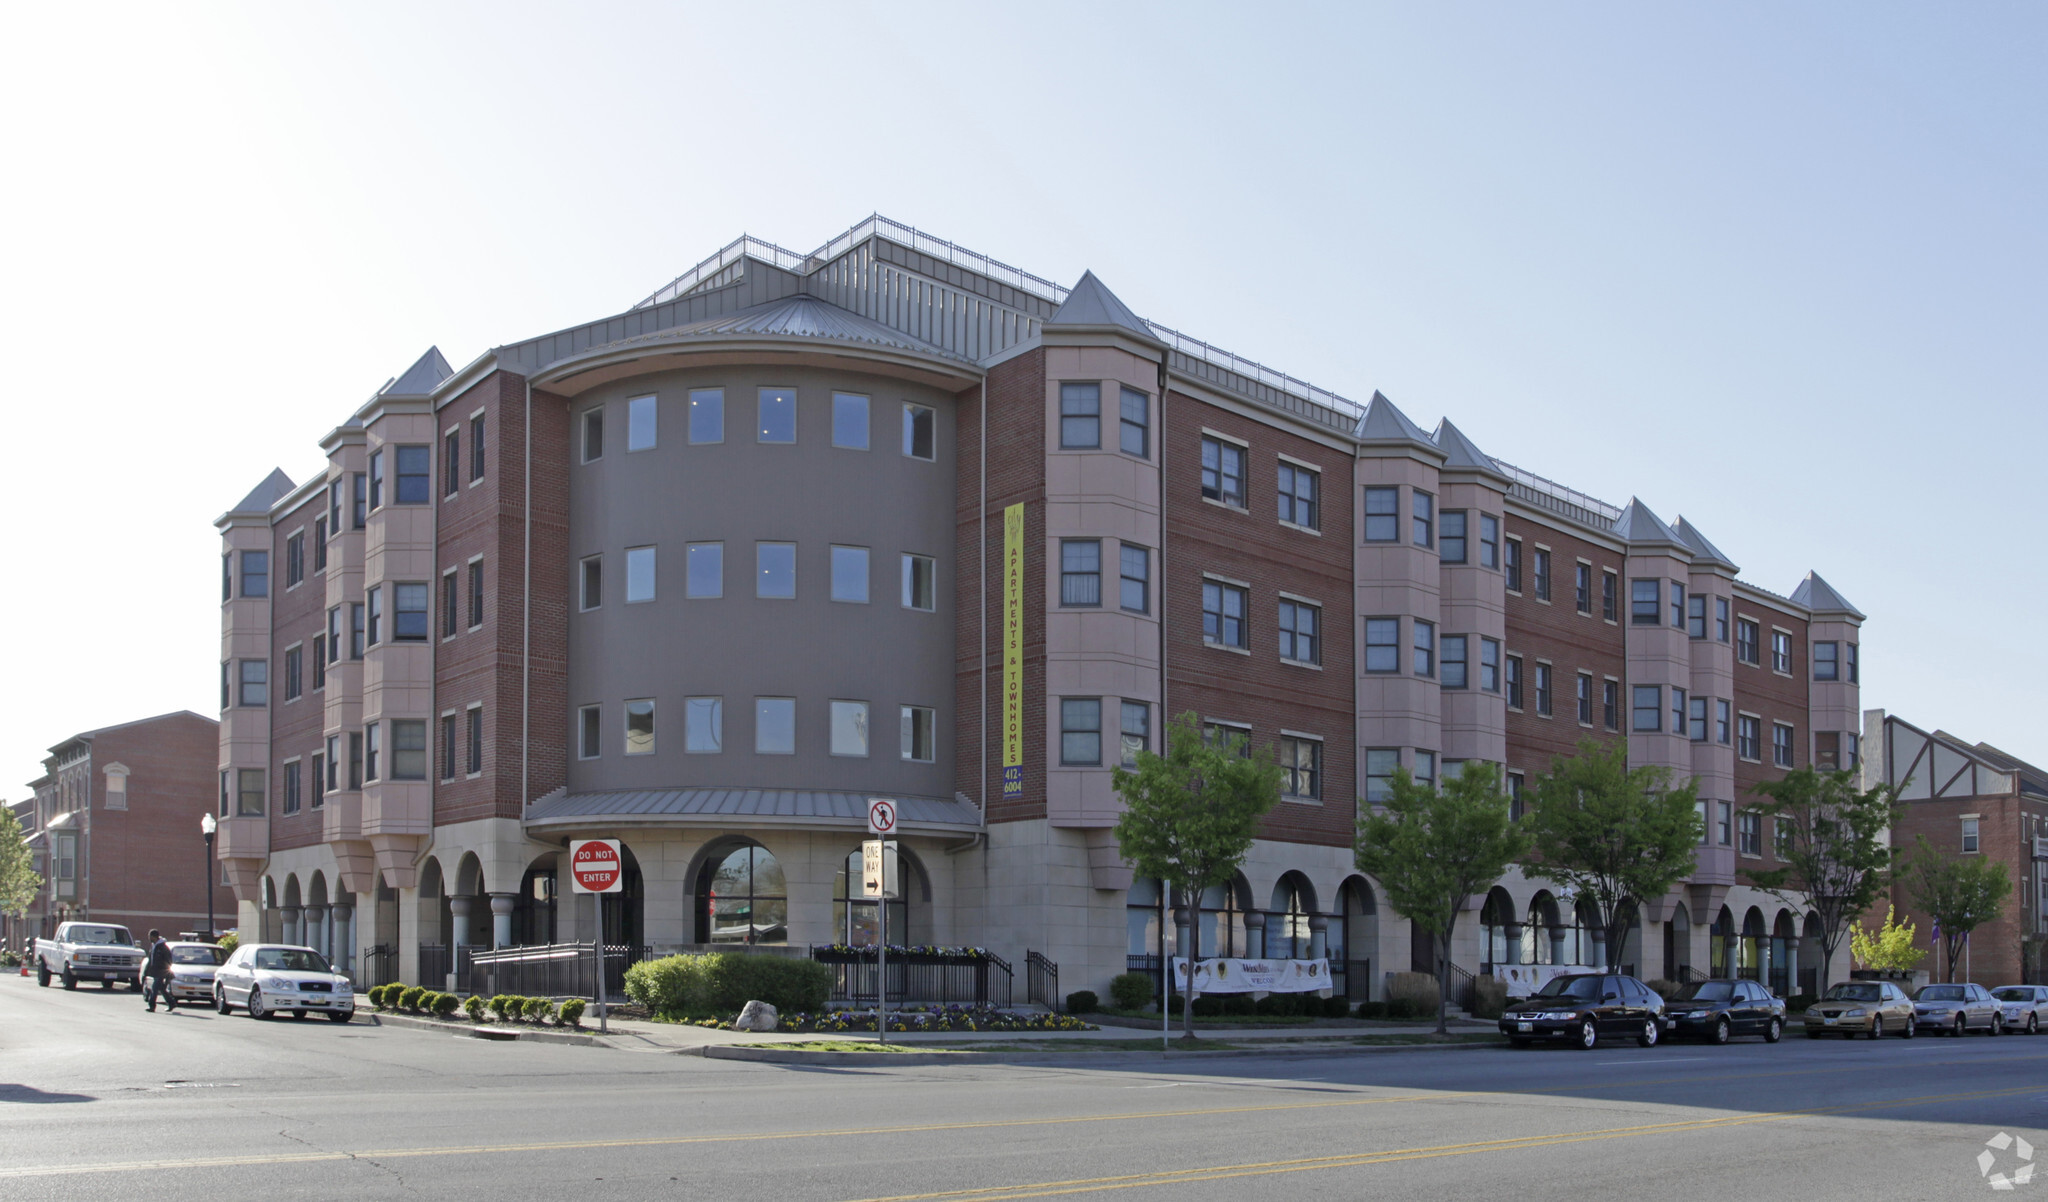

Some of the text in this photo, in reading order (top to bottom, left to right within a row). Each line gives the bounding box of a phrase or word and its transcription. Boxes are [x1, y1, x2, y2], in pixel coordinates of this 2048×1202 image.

[1010, 657, 1016, 666] &
[1009, 671, 1017, 763] TOWNHOMES
[1004, 780, 1022, 793] 6004
[579, 850, 613, 860] DO NOT
[866, 846, 879, 858] ONE
[866, 861, 879, 873] WAY
[583, 873, 611, 883] ENTER
